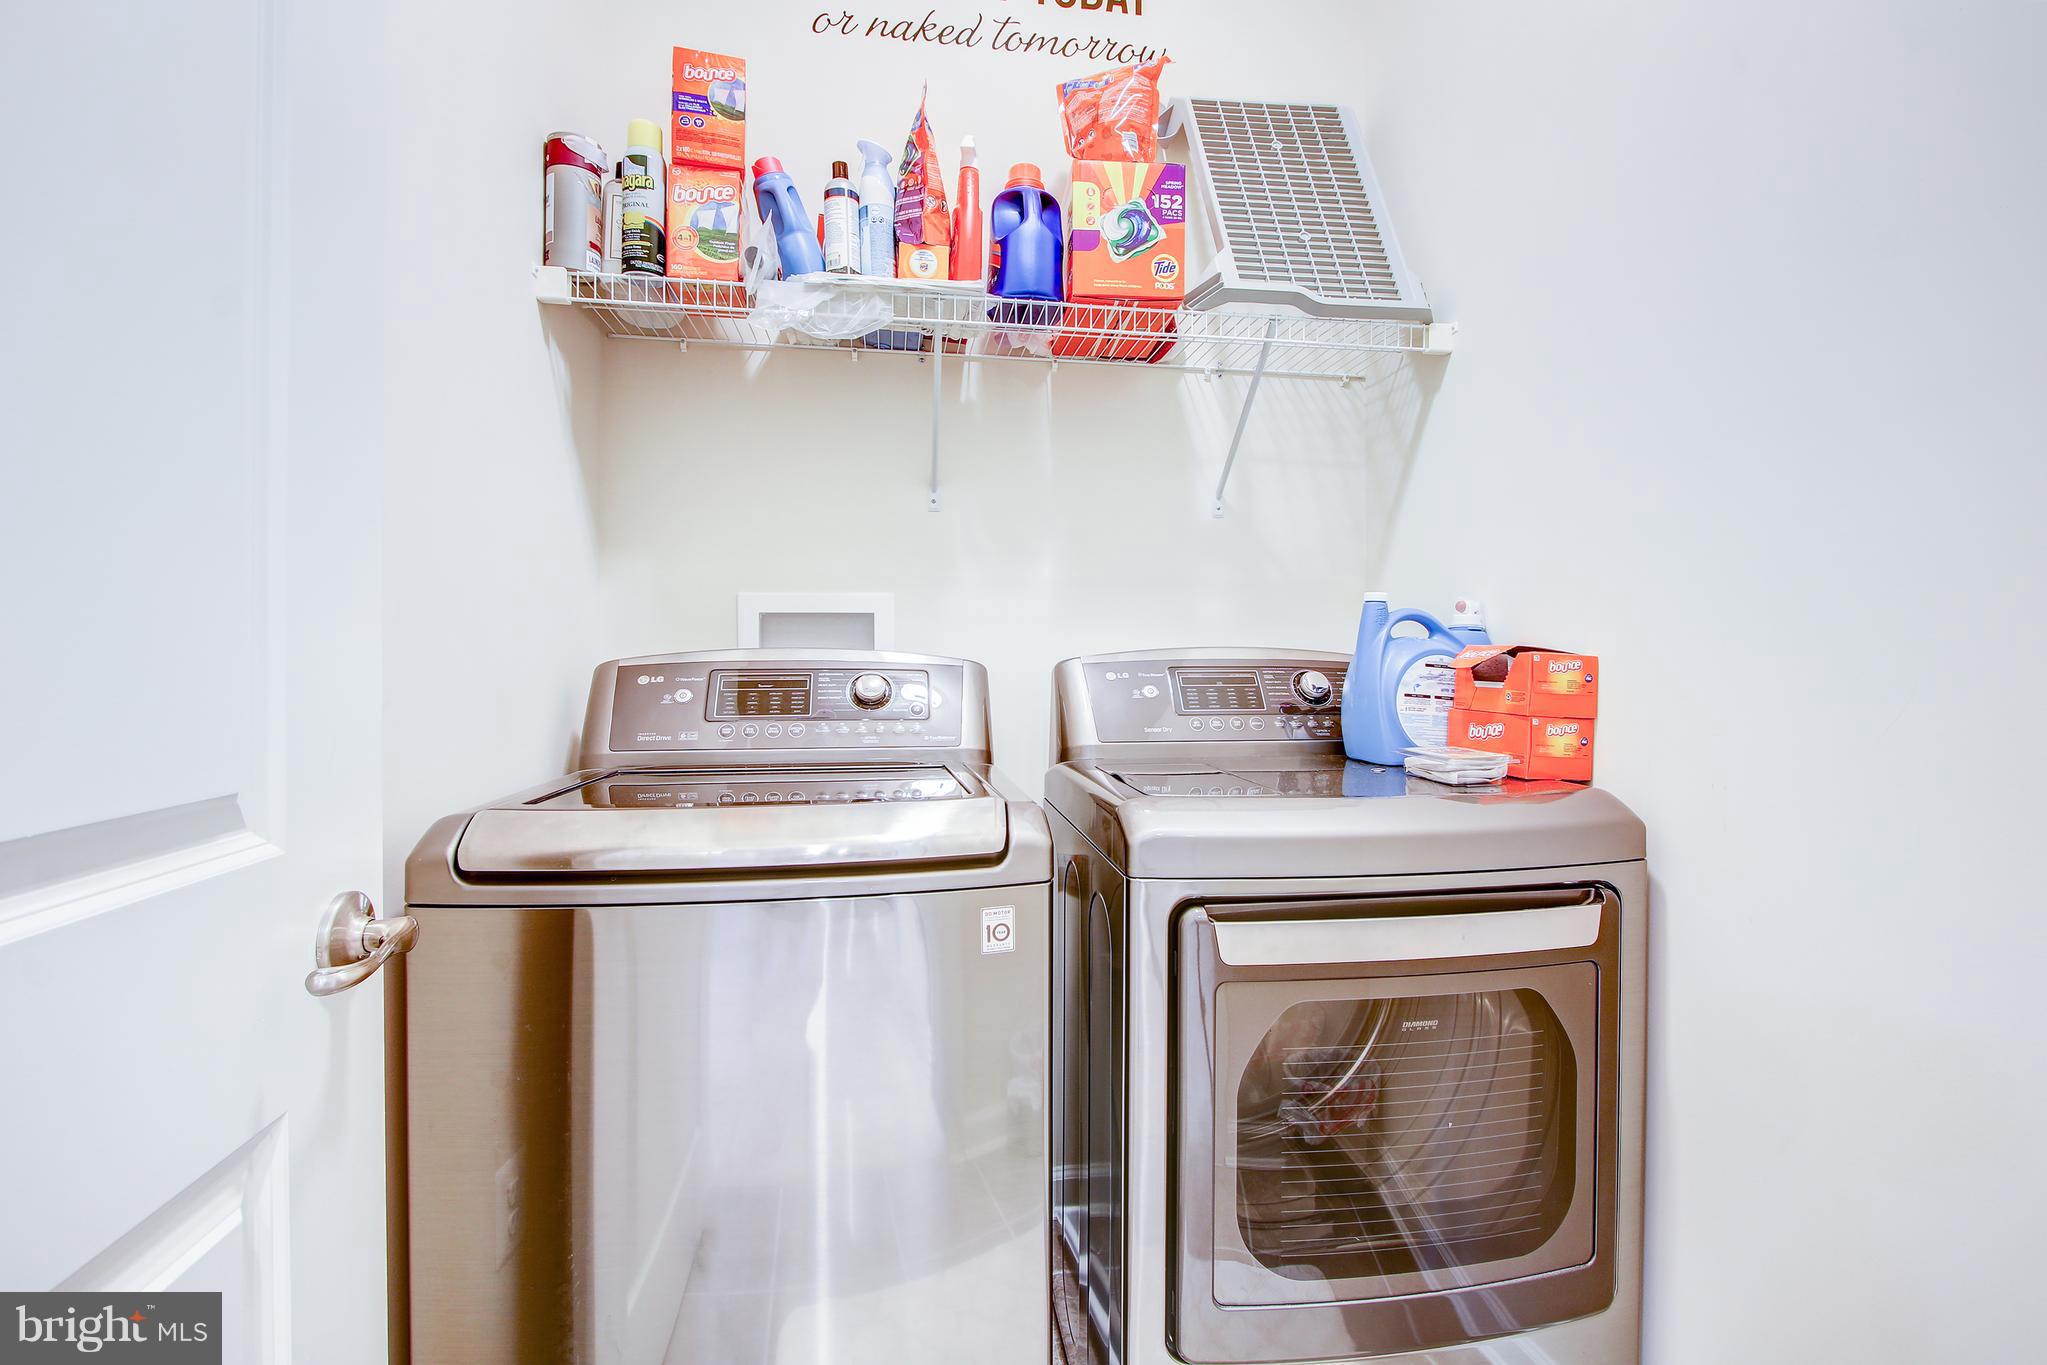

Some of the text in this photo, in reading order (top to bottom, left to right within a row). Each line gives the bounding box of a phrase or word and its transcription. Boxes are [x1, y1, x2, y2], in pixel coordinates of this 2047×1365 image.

[812, 10, 858, 35] or
[865, 9, 983, 48] naked
[683, 63, 736, 82] bounce
[621, 174, 655, 193] agara
[672, 184, 736, 204] bounce
[1151, 194, 1183, 209] 152
[1153, 261, 1176, 276] Tide
[1154, 282, 1175, 290] PODS
[1548, 659, 1583, 674] bounce
[1468, 723, 1505, 741] bounce
[1546, 723, 1579, 737] bounce
[986, 923, 1010, 943] 10
[1402, 1019, 1439, 1028] DIAMOND
